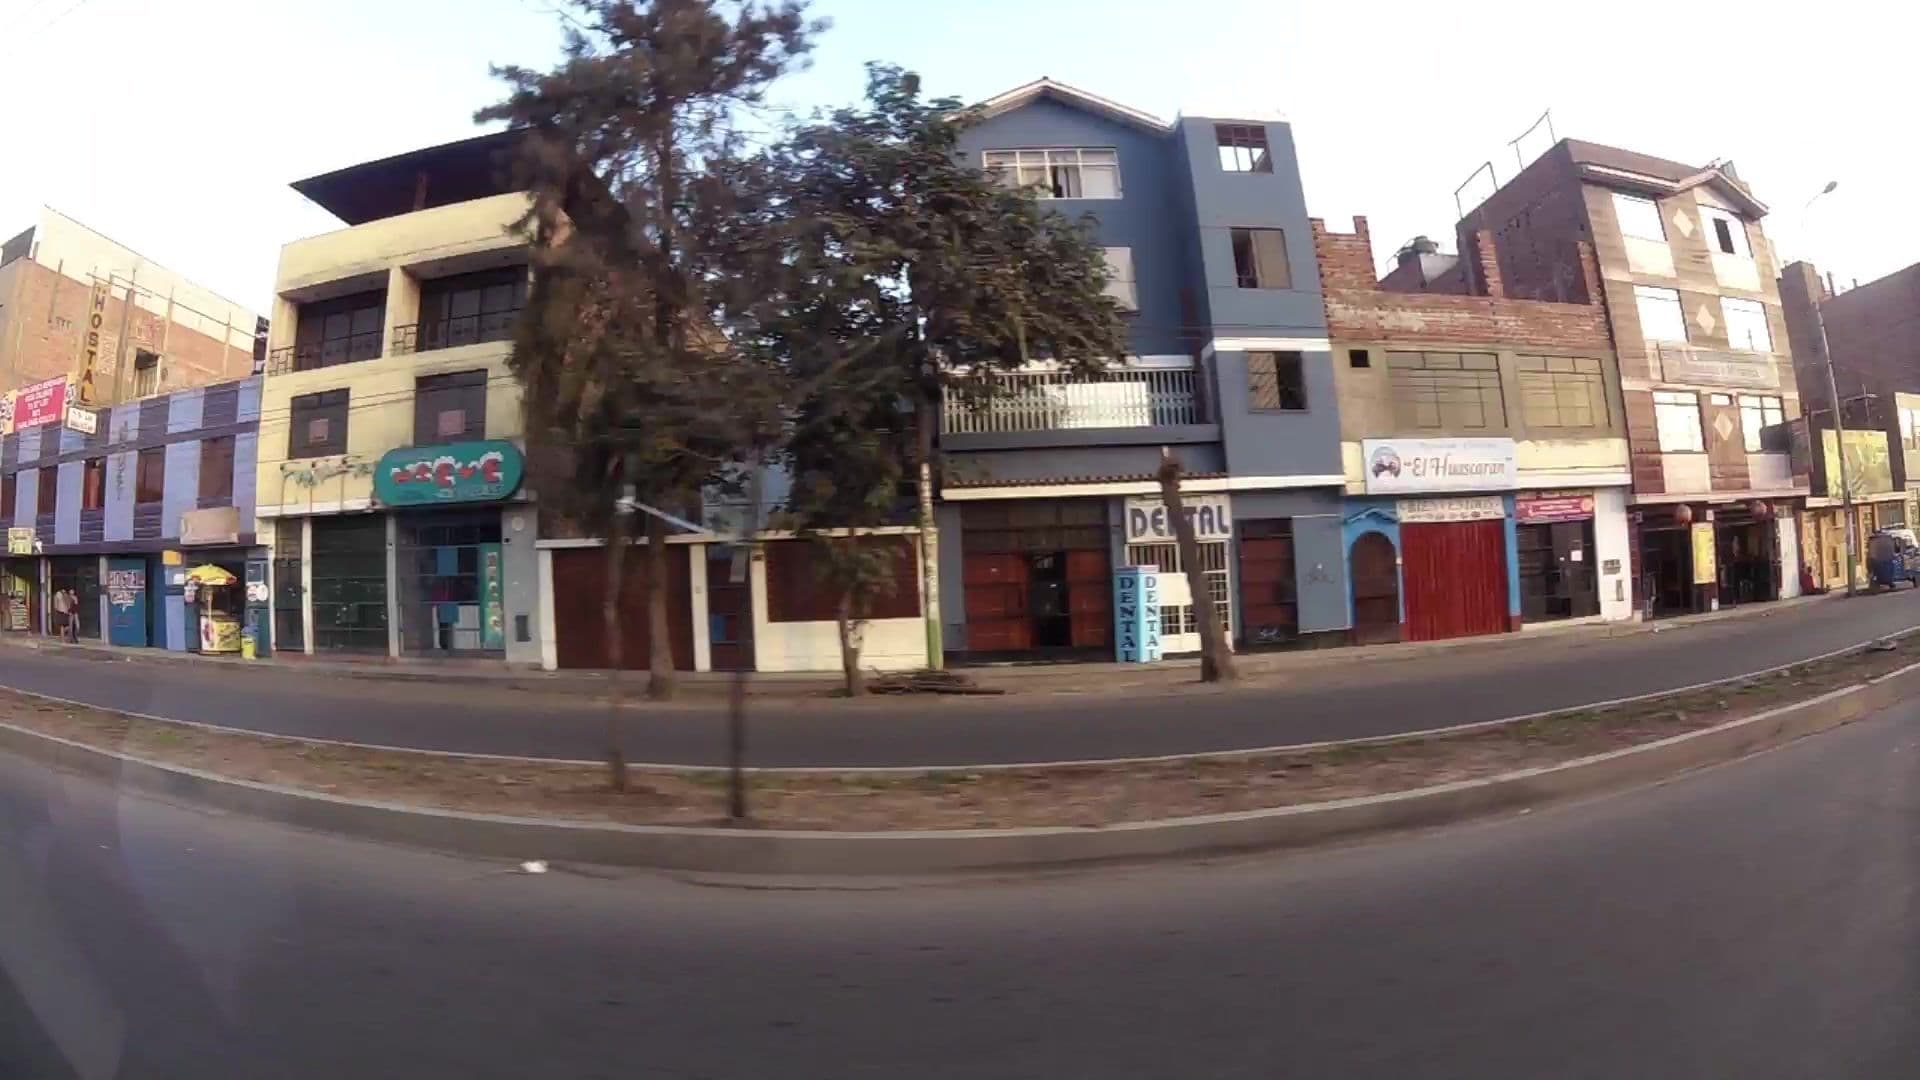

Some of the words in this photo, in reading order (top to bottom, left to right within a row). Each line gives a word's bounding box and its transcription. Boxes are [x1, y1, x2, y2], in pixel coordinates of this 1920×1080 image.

[81, 294, 105, 402] HOSTAL
[1412, 457, 1428, 477] El
[1130, 504, 1230, 538] DETAL
[1120, 576, 1136, 663] DENTAL
[1145, 576, 1159, 662] DENTAL
